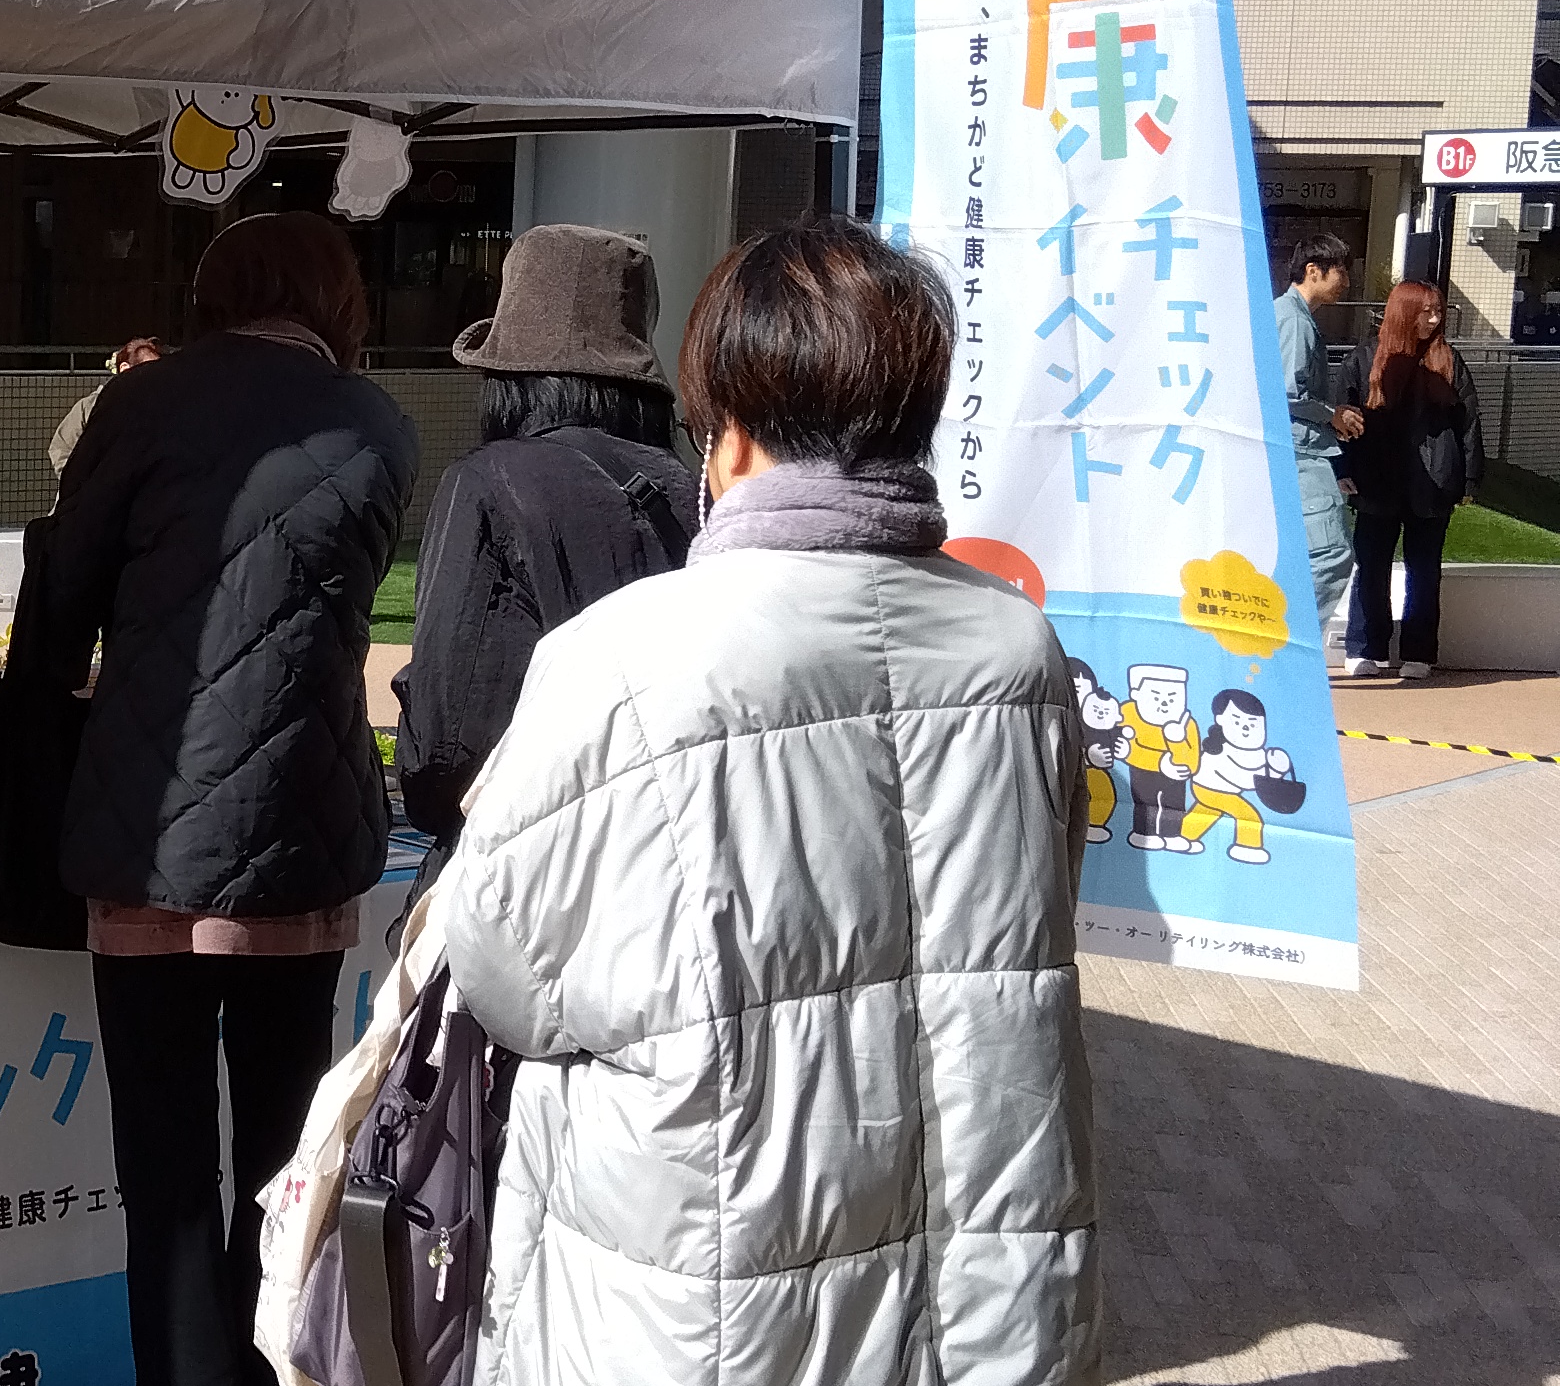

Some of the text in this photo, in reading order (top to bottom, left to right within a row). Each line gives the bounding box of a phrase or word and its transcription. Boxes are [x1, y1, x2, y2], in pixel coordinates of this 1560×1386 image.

[1035, 204, 1123, 504] イベント
[1121, 195, 1214, 506] チェック
[1199, 586, 1270, 609] 買い物ついでに
